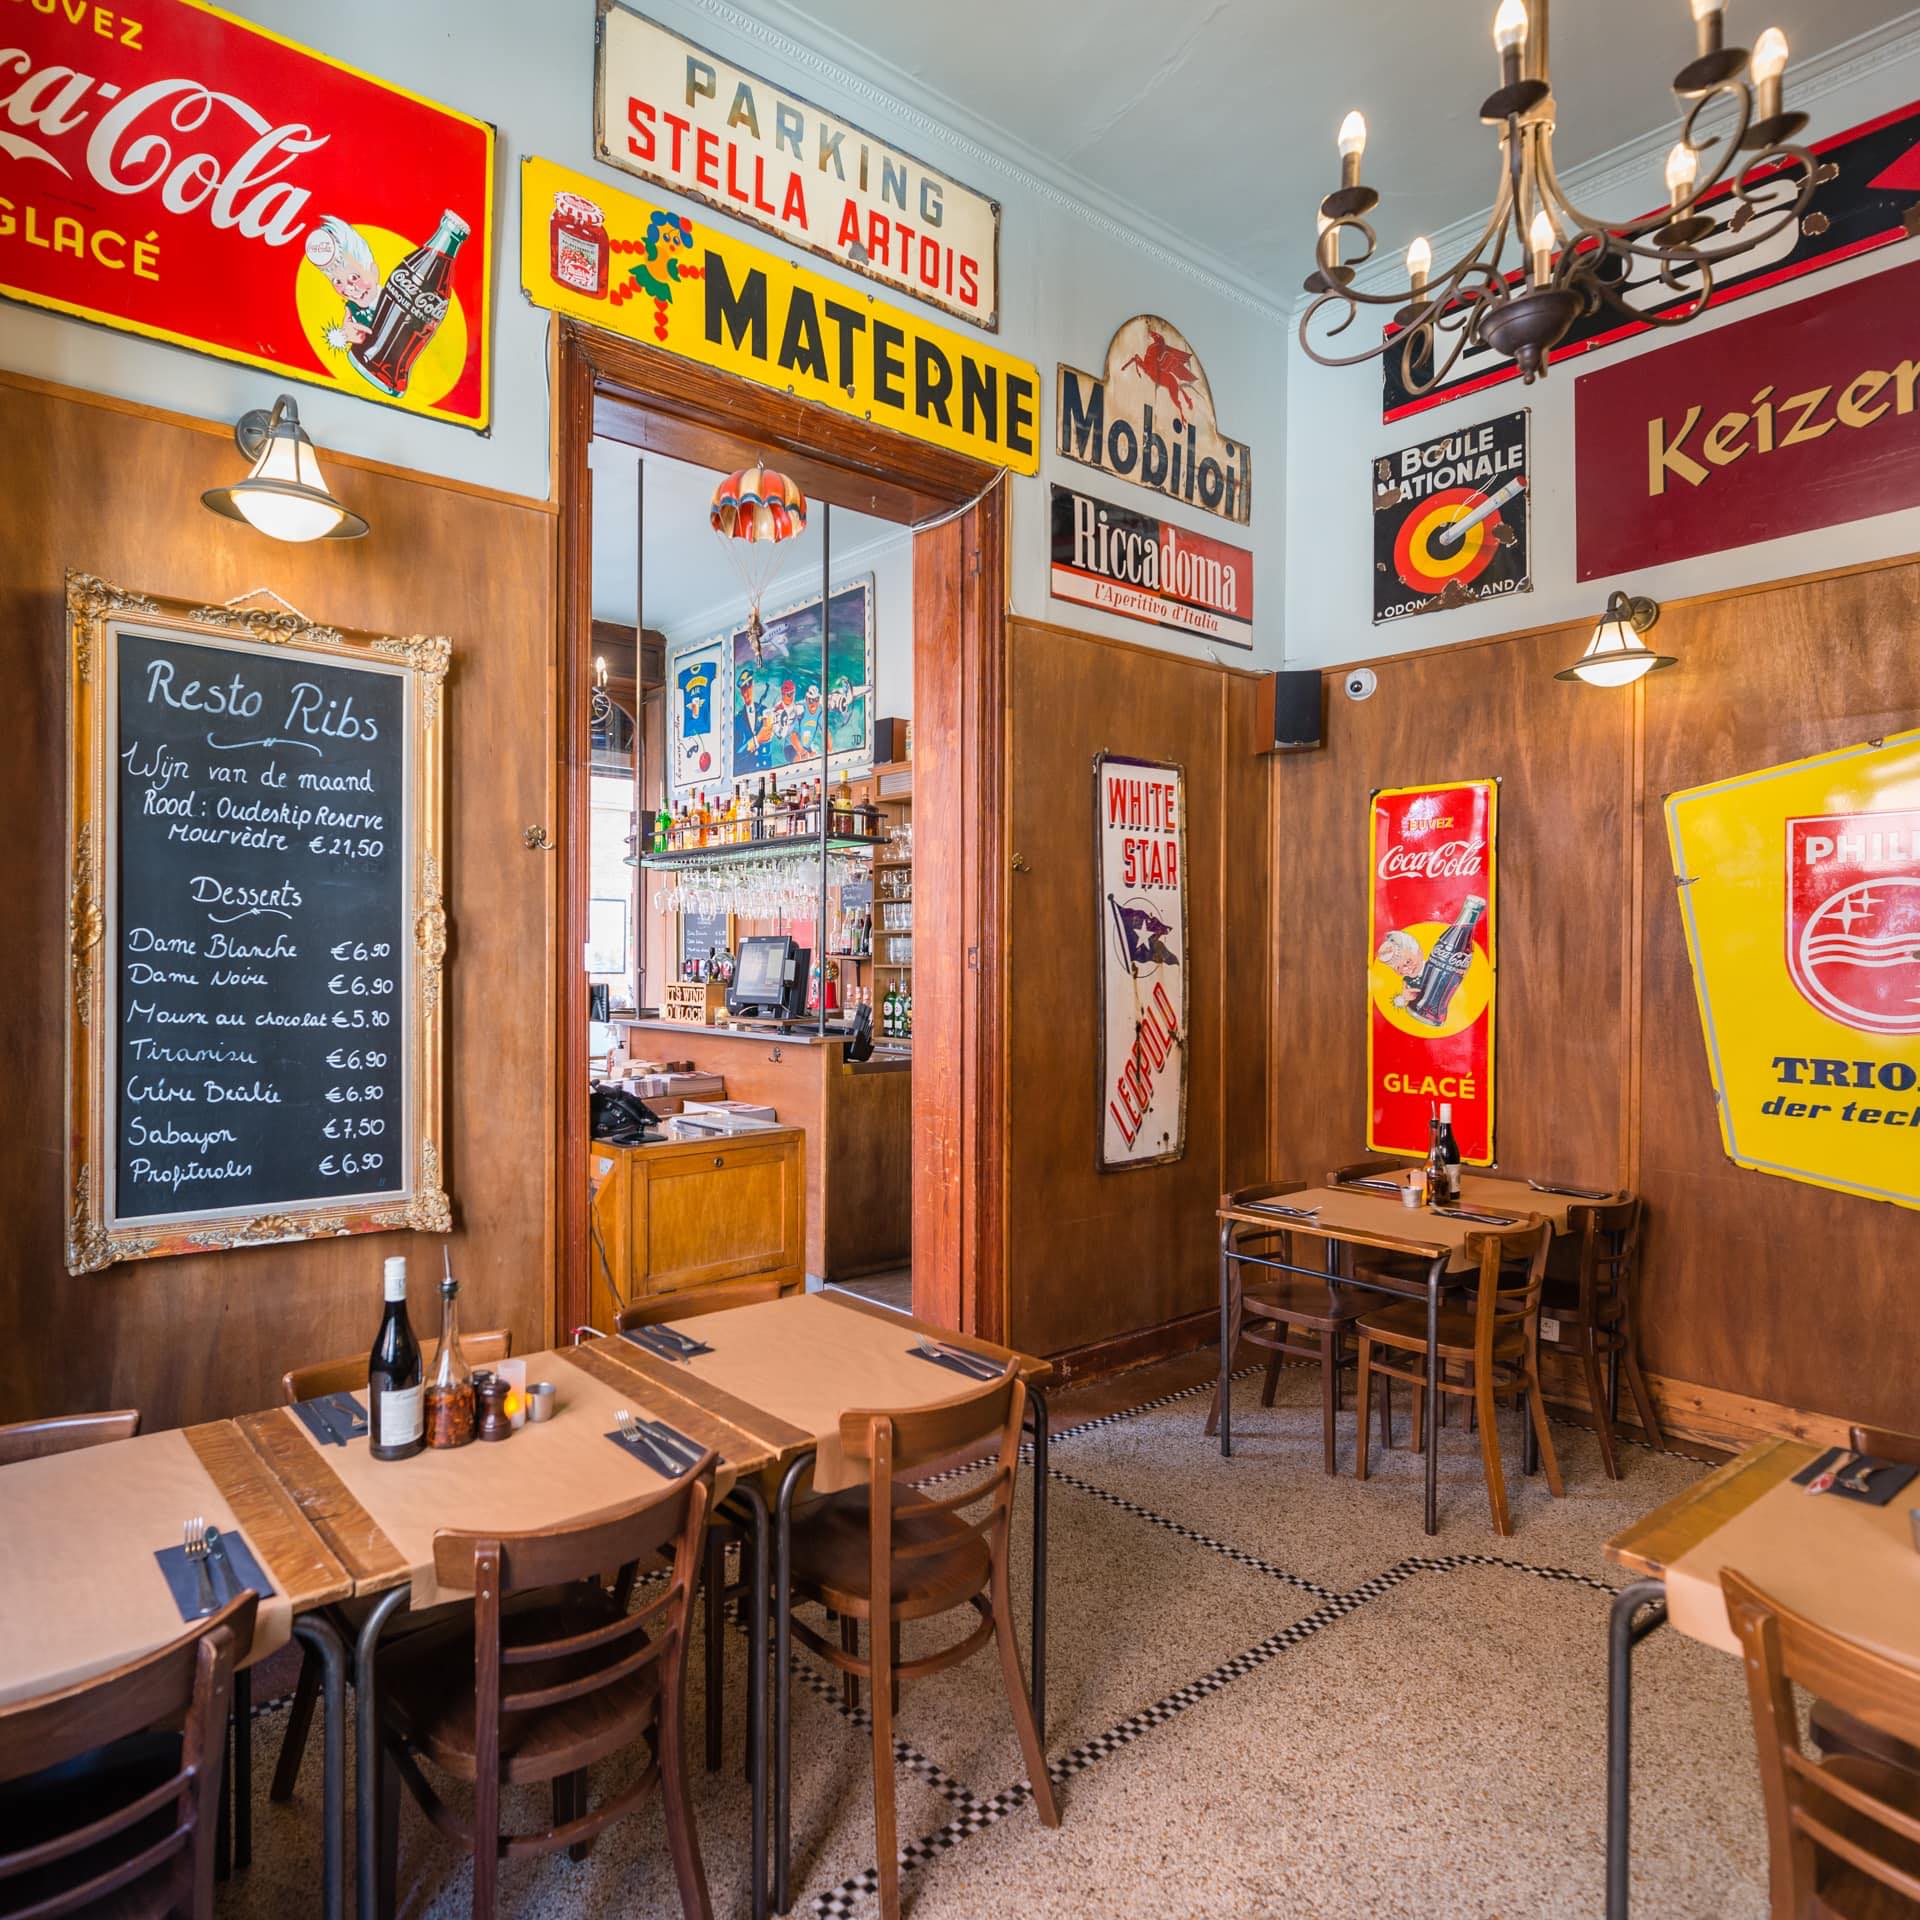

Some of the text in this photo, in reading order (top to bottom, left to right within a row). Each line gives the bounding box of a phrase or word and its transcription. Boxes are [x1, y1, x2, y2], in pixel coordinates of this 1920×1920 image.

[686, 55, 943, 229] PARKING
[628, 97, 978, 307] STELLA ARTOIS
[0, 196, 161, 282] GLACÉ
[704, 249, 1033, 457] MATERNE
[1062, 371, 1250, 521] Mobiloil
[1401, 427, 1494, 477] BOULE
[1377, 444, 1523, 502] NATIONALE
[1072, 494, 1237, 612] Riccadonna
[1095, 583, 1218, 631] l'Aperitivo d'Italia
[147, 660, 379, 742] Resto Ribs
[208, 765, 248, 784] van
[260, 760, 289, 788] de
[298, 768, 375, 793] maand
[314, 806, 384, 831] Reserve
[1108, 776, 1176, 833] WHITE
[168, 823, 289, 851] Mourvèdre
[1409, 817, 1455, 831] BUVEZ
[1124, 837, 1177, 890] STAR
[1377, 840, 1487, 881] Coca-Cola
[190, 875, 303, 906] Desserts
[128, 927, 198, 954] Dame
[204, 933, 298, 959] Blanche
[127, 963, 200, 985] Dame
[683, 986, 704, 1003] WINE
[215, 1012, 247, 1026] au
[255, 1010, 327, 1027] chocolat
[129, 1037, 259, 1064] Tiramisu
[1110, 981, 1178, 1152] LEOPOLD
[1383, 1072, 1476, 1100] GLACÉ
[1772, 1056, 1920, 1092] TRIO
[1761, 1096, 1832, 1119] der
[128, 1116, 238, 1154] Sabayon
[129, 1158, 253, 1193] Profiteroles
